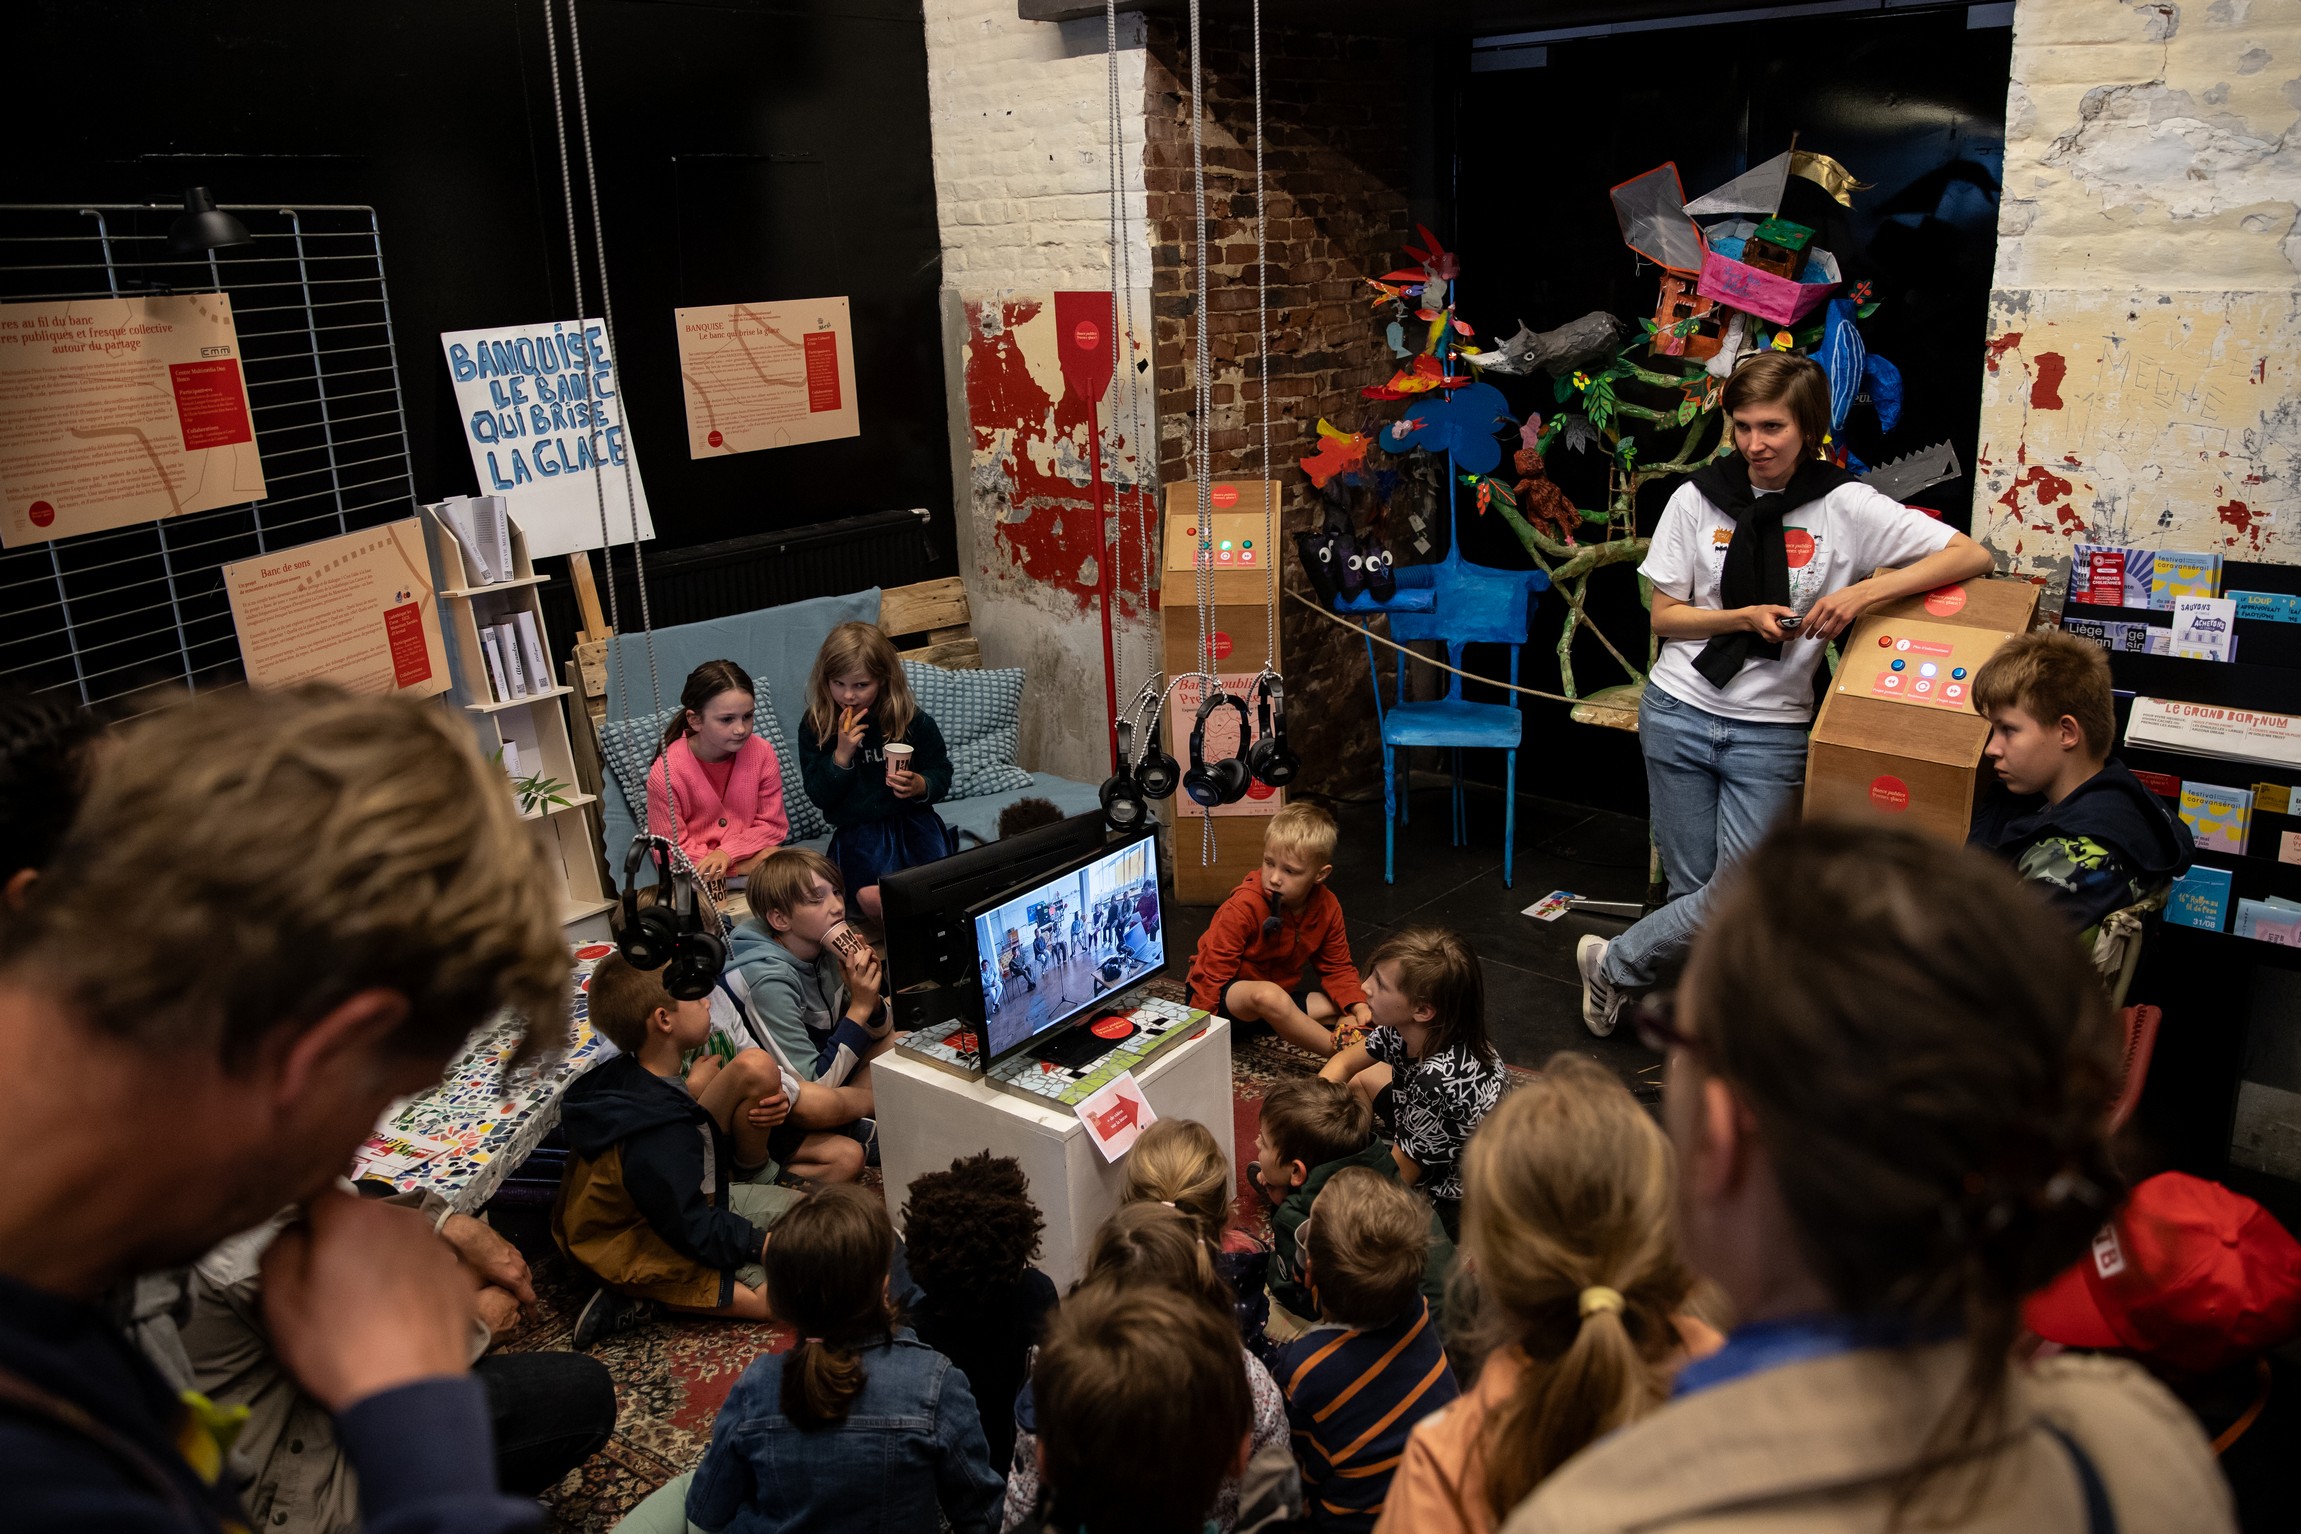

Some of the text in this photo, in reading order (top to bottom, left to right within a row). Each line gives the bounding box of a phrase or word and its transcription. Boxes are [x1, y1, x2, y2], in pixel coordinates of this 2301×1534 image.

[0, 316, 94, 330] res au fil du banc
[686, 322, 724, 332] BANQUISE
[0, 323, 173, 346] res publiques et fresque collective
[727, 330, 737, 339] qui
[739, 329, 755, 337] brise
[52, 340, 141, 354] autour du partage
[449, 323, 612, 383] BANQUISE
[489, 371, 616, 411] LE BANC
[471, 401, 610, 445] QUI BRISE
[487, 425, 626, 490] LA GLACE
[2158, 555, 2186, 563] festival
[261, 560, 311, 578] Banc de sons
[2158, 562, 2209, 571] caravansérail
[2248, 596, 2272, 605] LOUP
[2069, 623, 2103, 636] Liège
[2194, 619, 2225, 630] ACHETONS
[512, 642, 521, 675] Alexandra
[1221, 678, 1259, 689] publi
[1179, 694, 1203, 704] Pre
[2188, 790, 2217, 799] festival
[2187, 796, 2241, 809] caravansérail
[710, 889, 727, 902] HOT
[2193, 918, 2216, 928] 31/08
